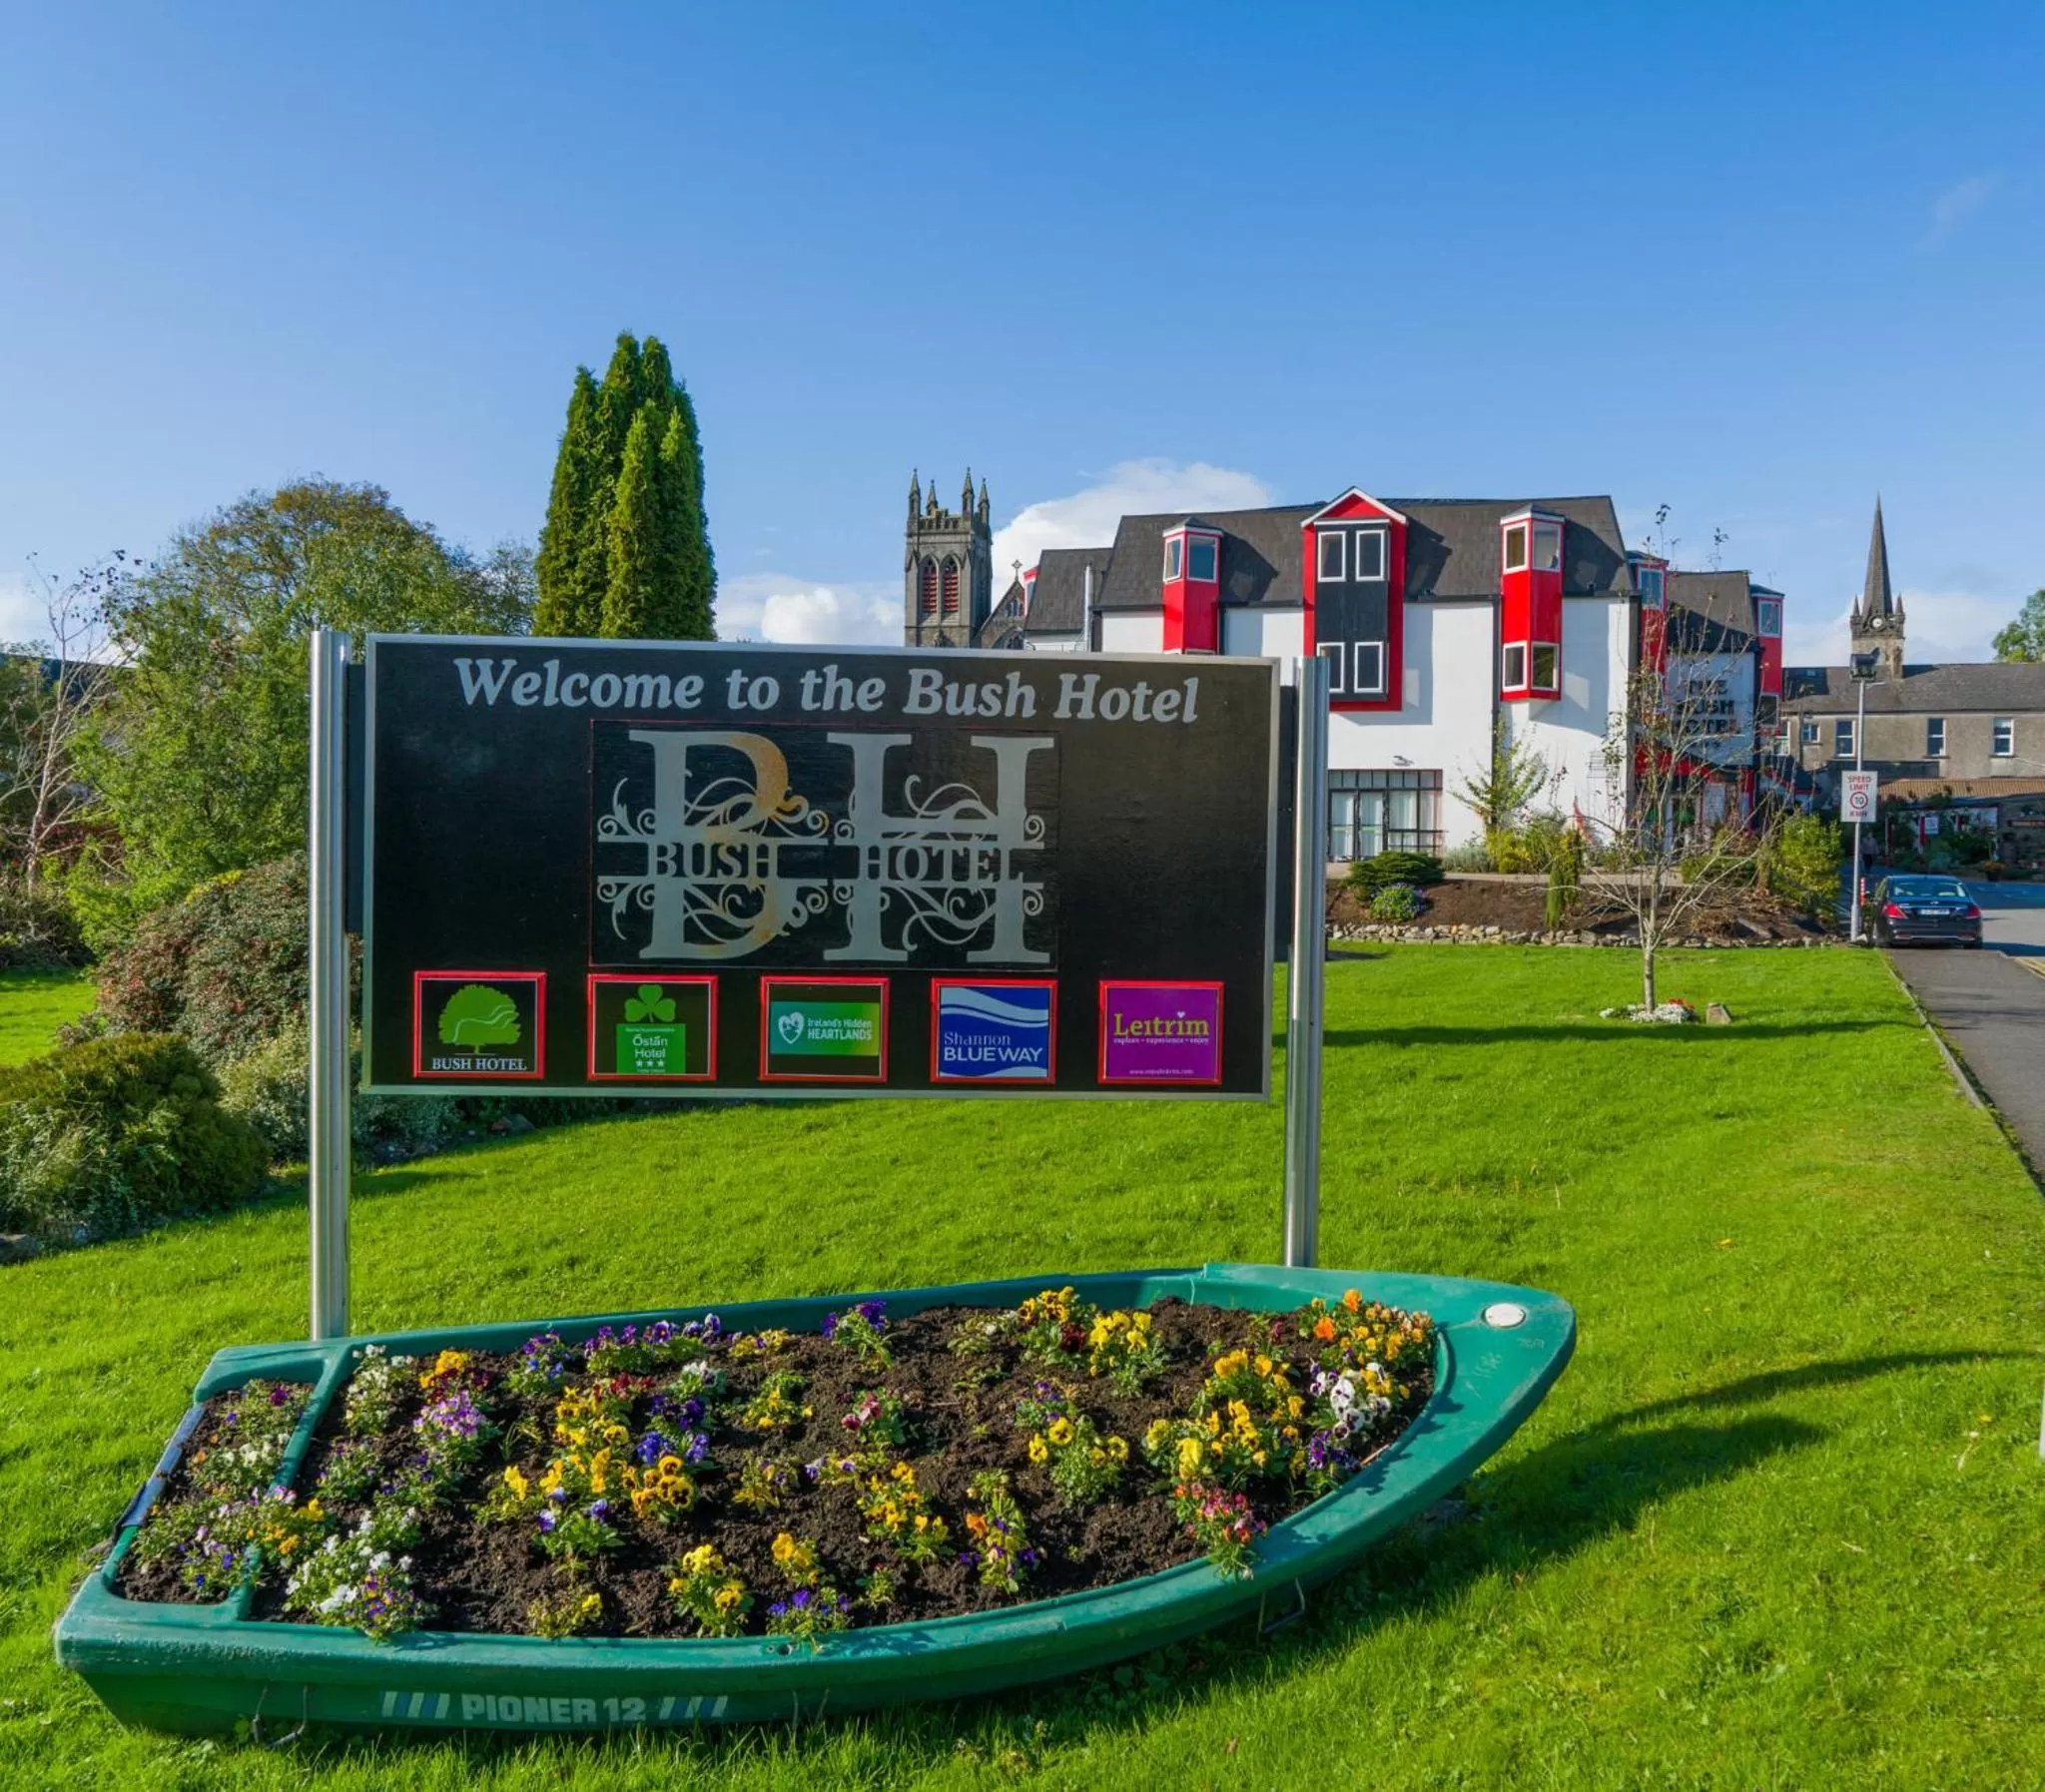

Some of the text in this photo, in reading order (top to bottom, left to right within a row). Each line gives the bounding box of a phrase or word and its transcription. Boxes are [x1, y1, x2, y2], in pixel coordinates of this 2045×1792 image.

[452, 657, 1199, 724] Welcome to the Bush Hotel
[1847, 775, 1871, 784] SPEED
[647, 841, 1025, 886] BUSH HOTEL
[843, 1018, 873, 1029] Hidden
[1113, 1011, 1210, 1036] Leitrim
[807, 1028, 874, 1041] HEARTLANDS
[944, 1031, 1012, 1047] Shannon
[634, 1047, 667, 1058] Hotel
[944, 1046, 1043, 1062] BLUEWAY
[430, 1057, 528, 1071] BUSH HOTEL
[461, 1693, 648, 1724] PIONER 12
